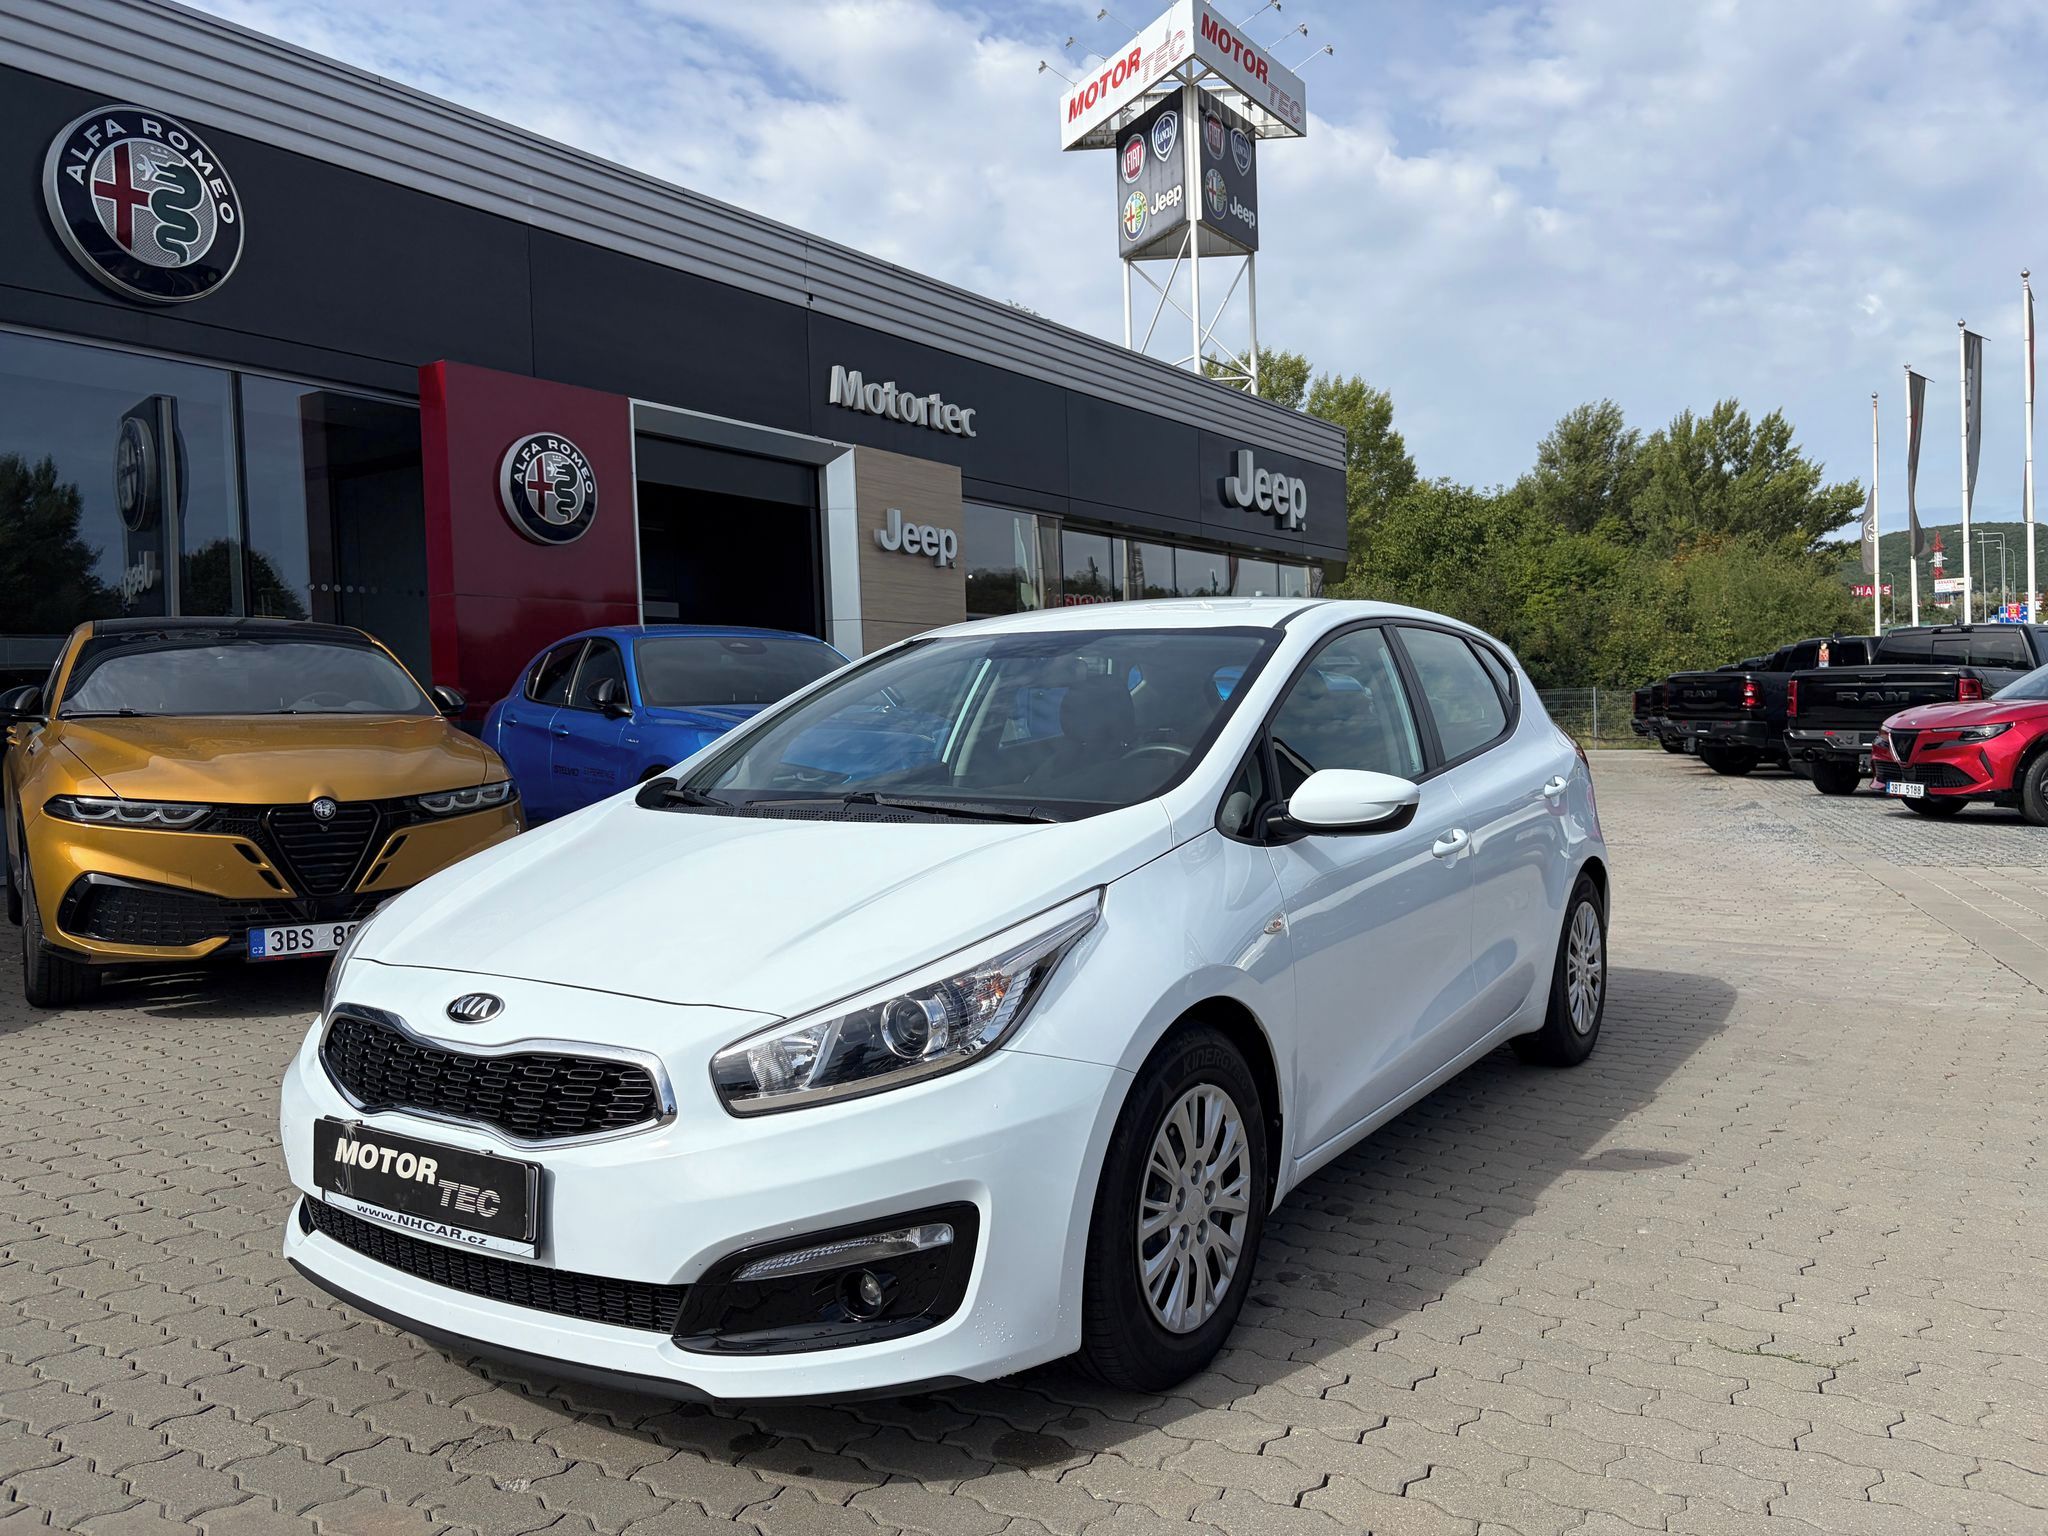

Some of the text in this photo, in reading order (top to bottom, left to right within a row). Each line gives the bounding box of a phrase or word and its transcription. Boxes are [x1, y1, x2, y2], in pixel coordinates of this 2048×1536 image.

[1068, 29, 1186, 123] MOTOR TEC
[1201, 12, 1301, 124] MOTOR TEC
[66, 117, 234, 224] ALFA ROMEO
[1126, 145, 1141, 173] FIAT
[1150, 184, 1183, 216] Jeep
[1230, 195, 1256, 229] Jeep
[829, 364, 977, 438] Motortec
[514, 439, 593, 493] ALFA ROMEO
[1223, 449, 1307, 532] Jeep
[874, 508, 958, 567] Jeep
[1836, 691, 1910, 701] RAM
[252, 946, 264, 954] CZ
[271, 928, 314, 952] 3BS
[450, 996, 493, 1017] KIA
[334, 1137, 501, 1218] MOTOR TEC
[356, 1204, 488, 1246] www.NHCAR.cz
